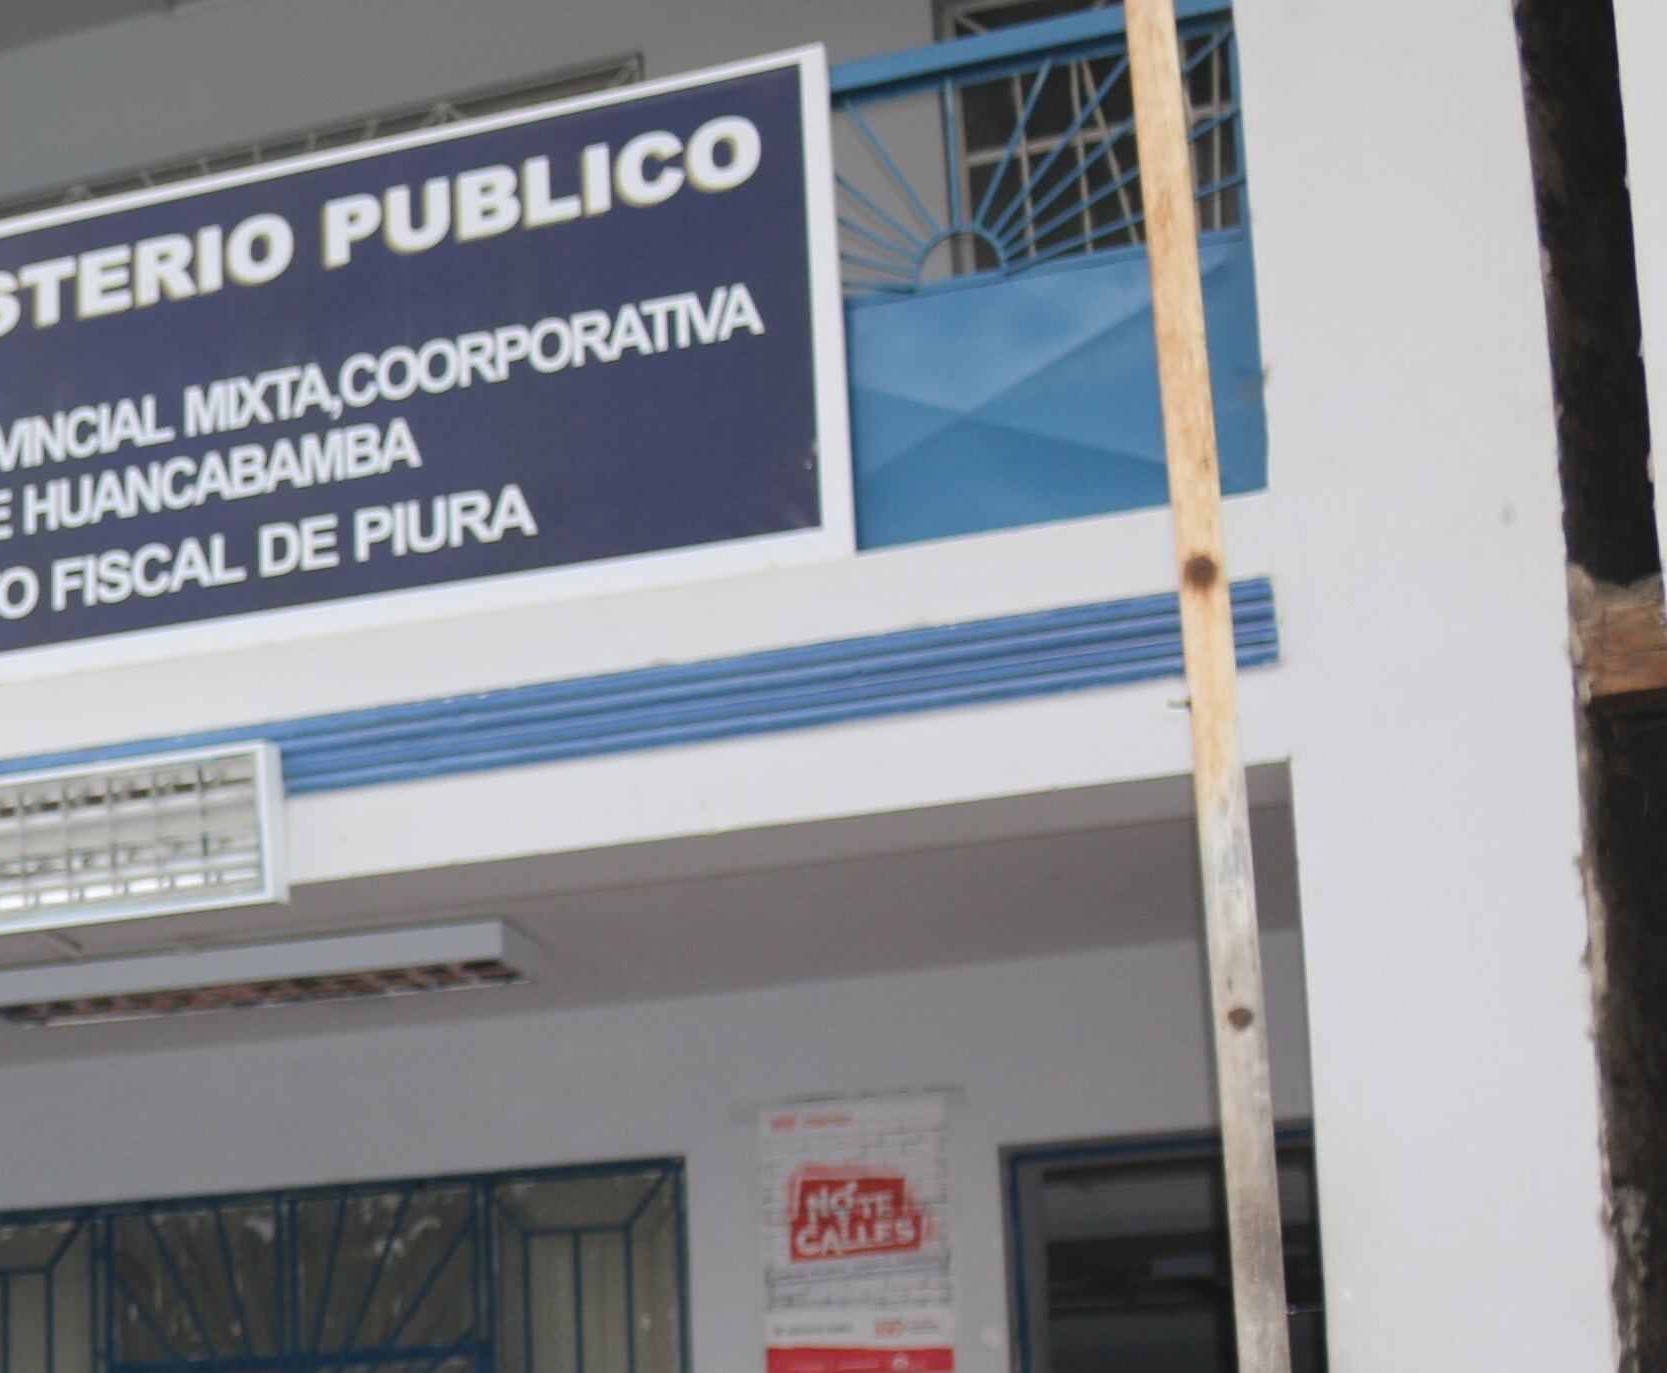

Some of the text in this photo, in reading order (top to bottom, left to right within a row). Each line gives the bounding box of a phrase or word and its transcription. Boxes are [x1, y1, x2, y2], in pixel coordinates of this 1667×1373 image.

[322, 115, 762, 269] PUBLICO
[23, 417, 422, 535] HUANCABAMBA
[51, 533, 247, 611] FISCAL
[258, 513, 340, 577] DE
[354, 484, 538, 562] PIURA
[795, 1216, 917, 1257] CALLES
[862, 1192, 896, 1218] TE
